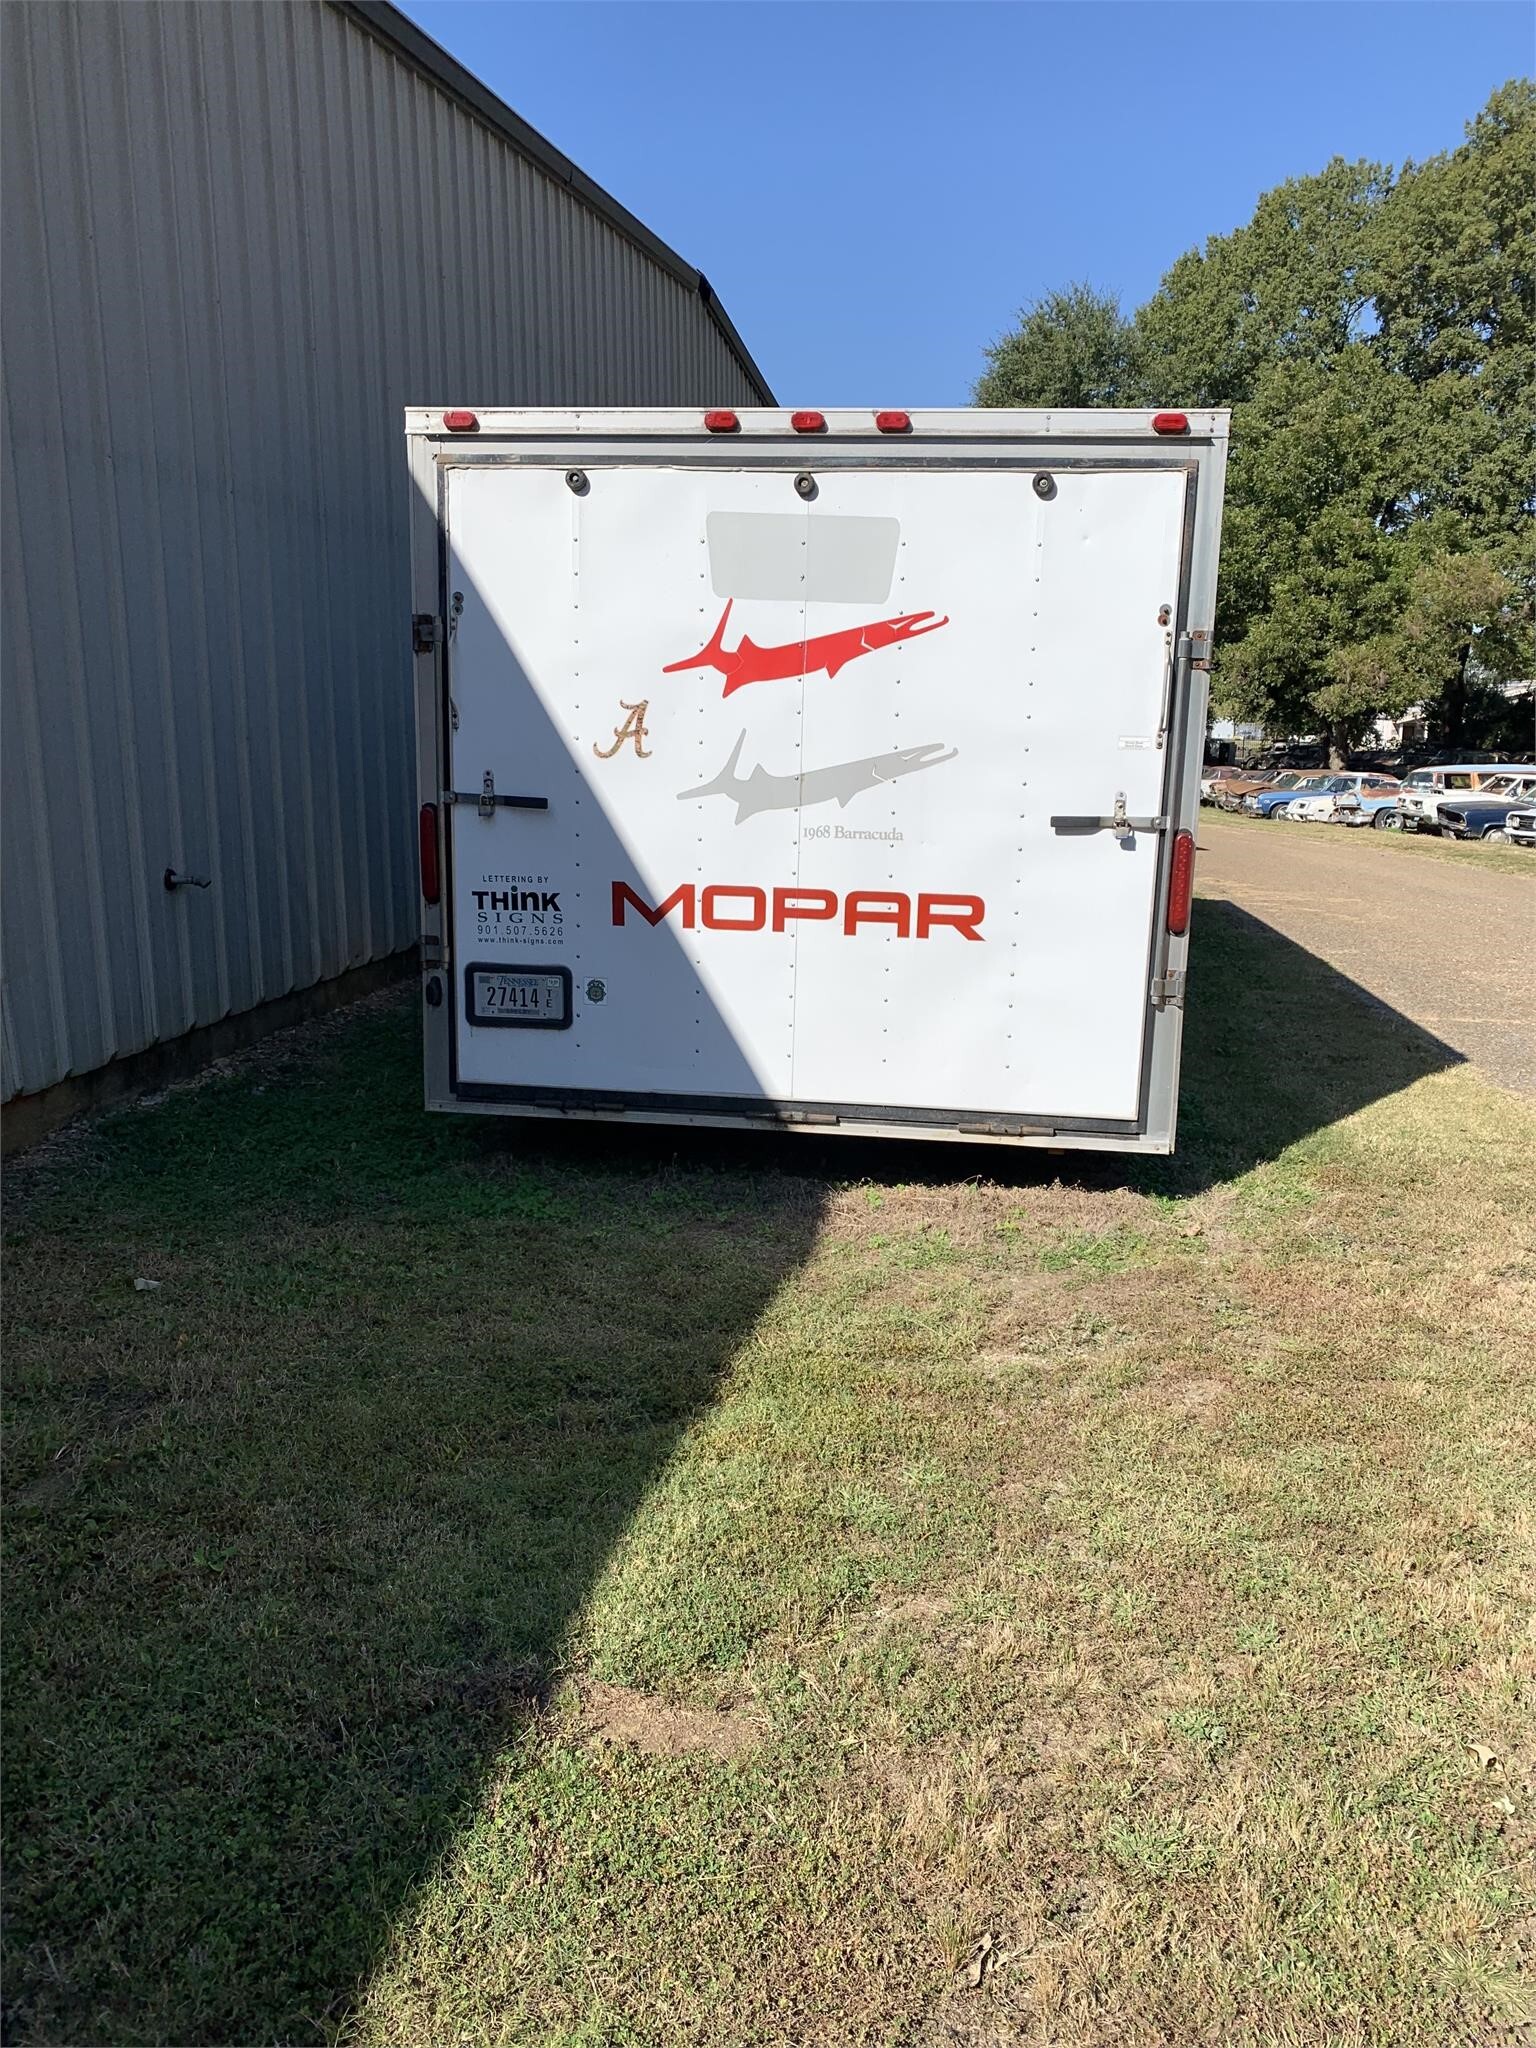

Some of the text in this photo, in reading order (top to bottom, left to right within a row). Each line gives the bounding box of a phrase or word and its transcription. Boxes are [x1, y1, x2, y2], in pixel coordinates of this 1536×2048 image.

[803, 825, 904, 841] 1968 Barracuda
[482, 875, 549, 884] LETTERING BY
[477, 911, 563, 924] SIGNS
[611, 880, 986, 942] MOPAR
[477, 936, 564, 946] www.think-signs.com
[486, 986, 540, 1009] 27414
